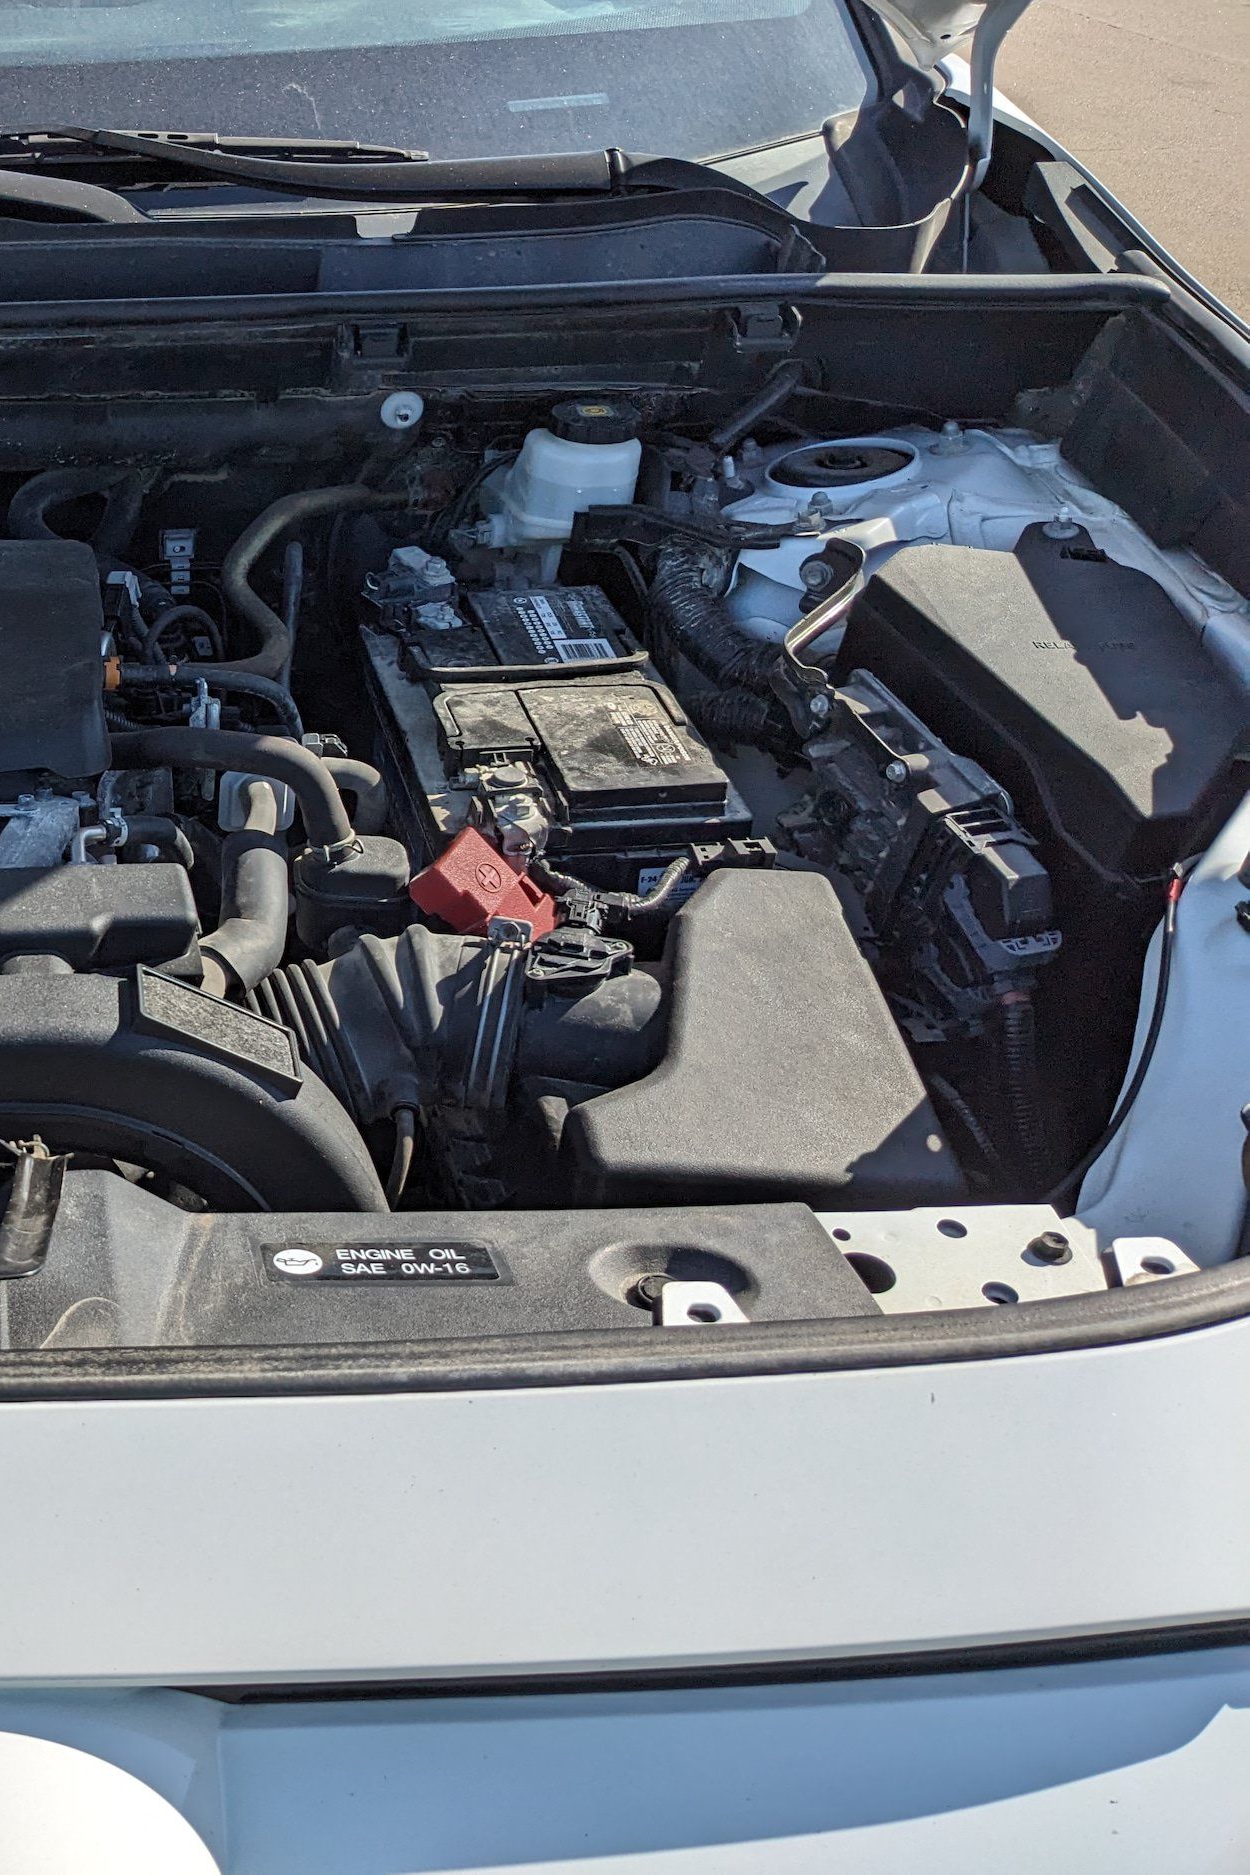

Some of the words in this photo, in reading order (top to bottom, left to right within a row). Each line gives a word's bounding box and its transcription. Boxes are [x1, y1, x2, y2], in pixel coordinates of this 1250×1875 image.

[335, 1248, 415, 1261] ENGINE
[428, 1248, 467, 1260] OIL
[341, 1262, 387, 1274] SAE
[401, 1262, 472, 1275] 0W-16
